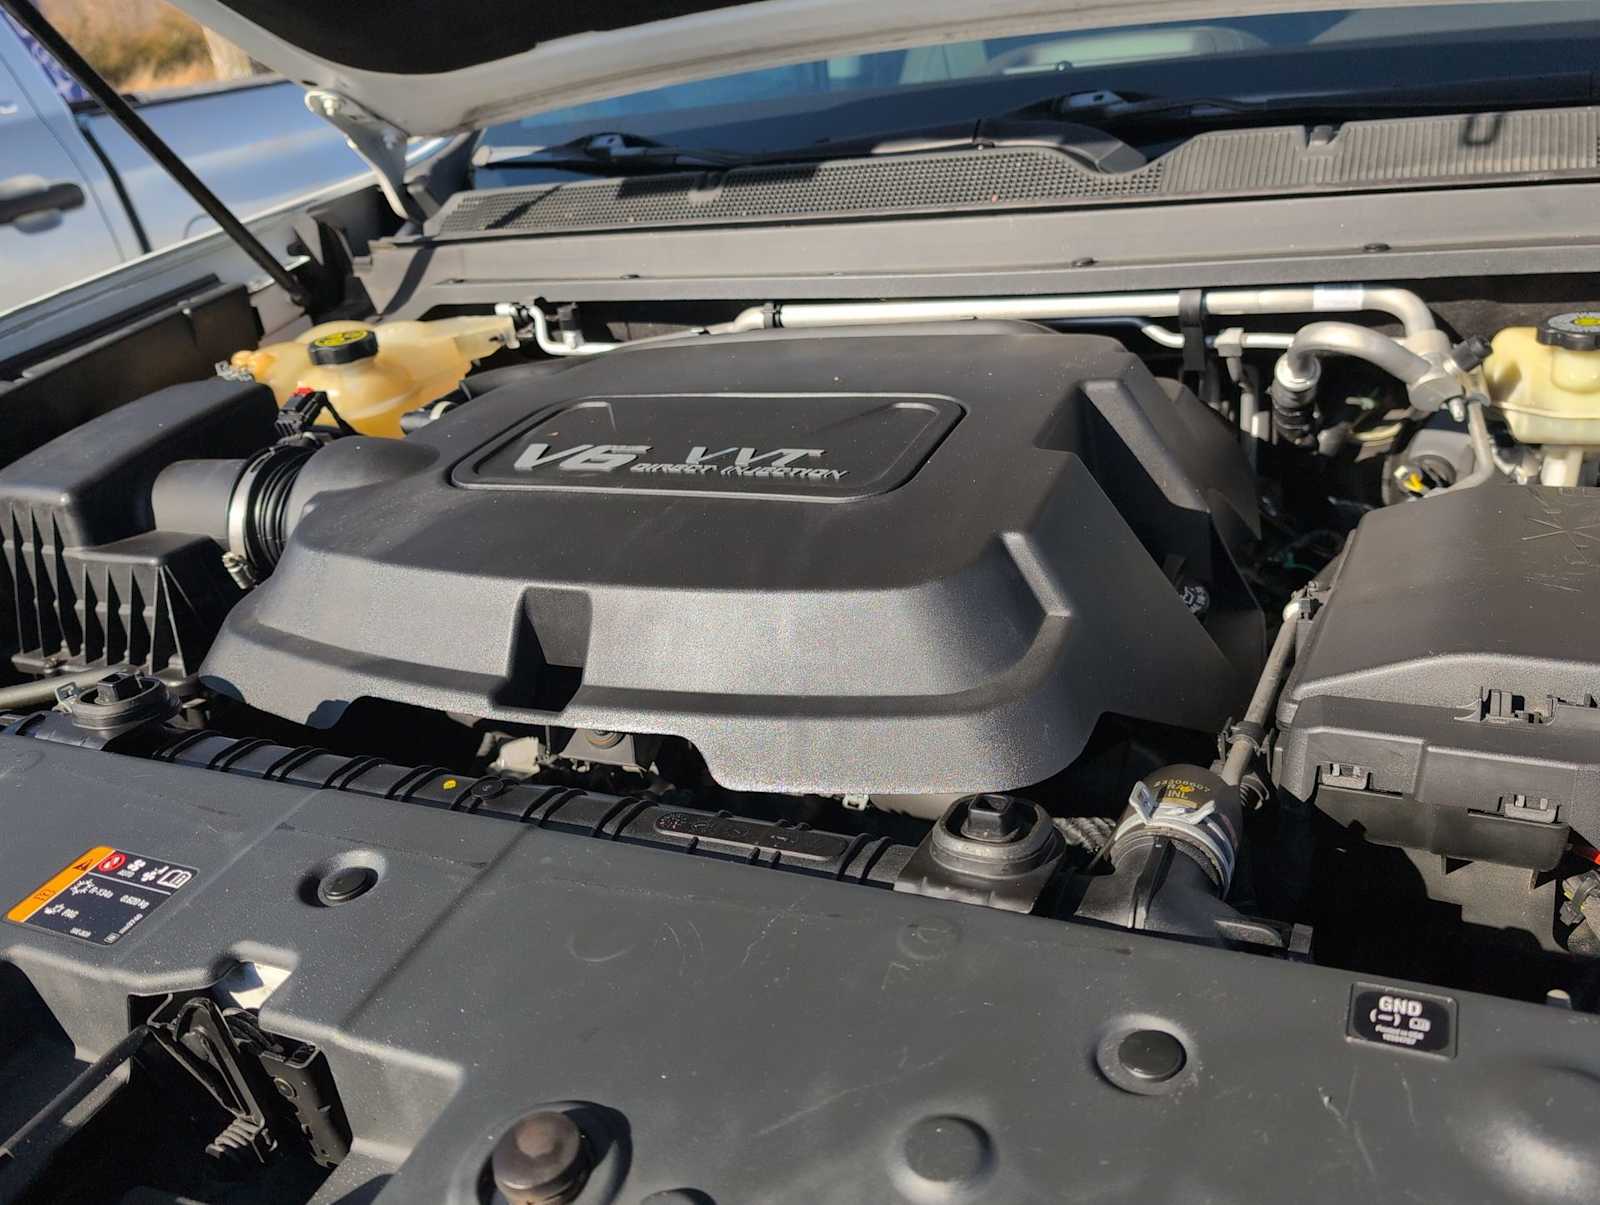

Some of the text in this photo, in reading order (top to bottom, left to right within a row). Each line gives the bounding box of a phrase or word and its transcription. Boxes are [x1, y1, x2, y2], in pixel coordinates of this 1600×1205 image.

[514, 443, 827, 472] V6 VVT
[630, 463, 849, 480] DIRECT INJECTION
[1378, 995, 1423, 1017] GND
